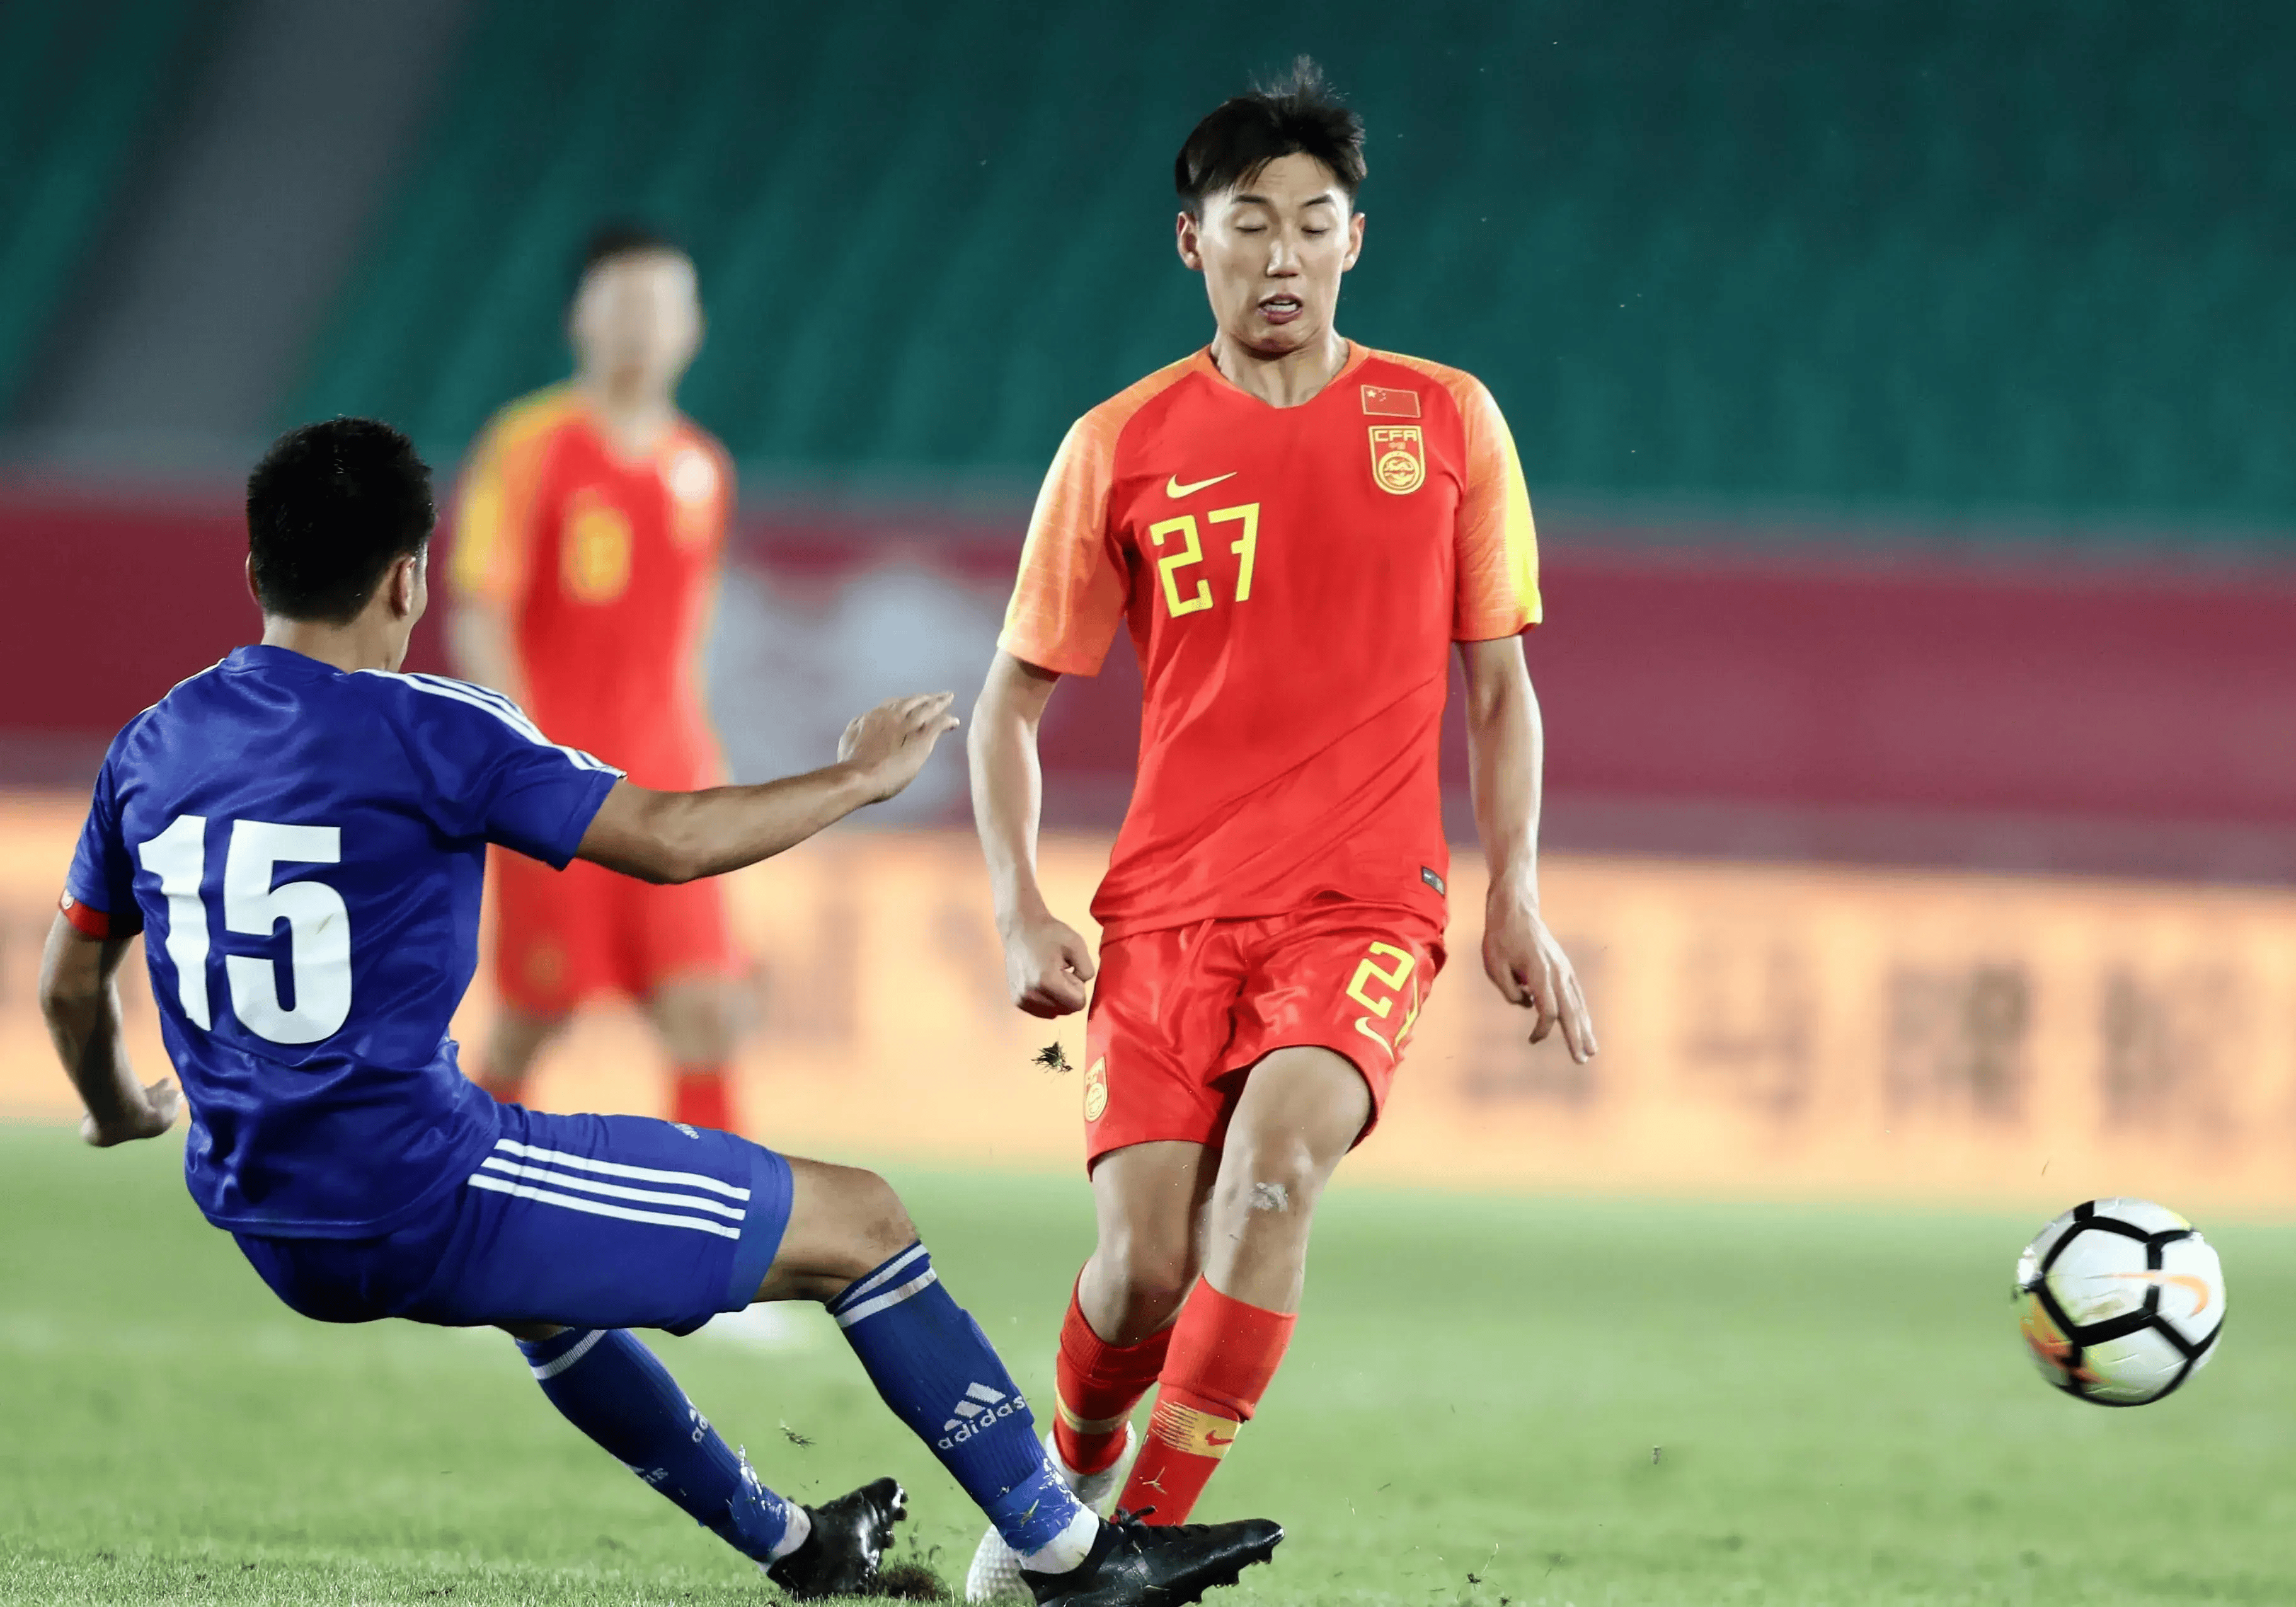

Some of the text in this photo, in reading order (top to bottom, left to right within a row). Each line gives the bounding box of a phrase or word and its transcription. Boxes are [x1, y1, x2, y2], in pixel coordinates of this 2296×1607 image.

[1375, 430, 1417, 441] CFA
[1149, 502, 1260, 618] 27
[138, 814, 352, 1044] 15
[938, 1395, 1026, 1449] adidas
